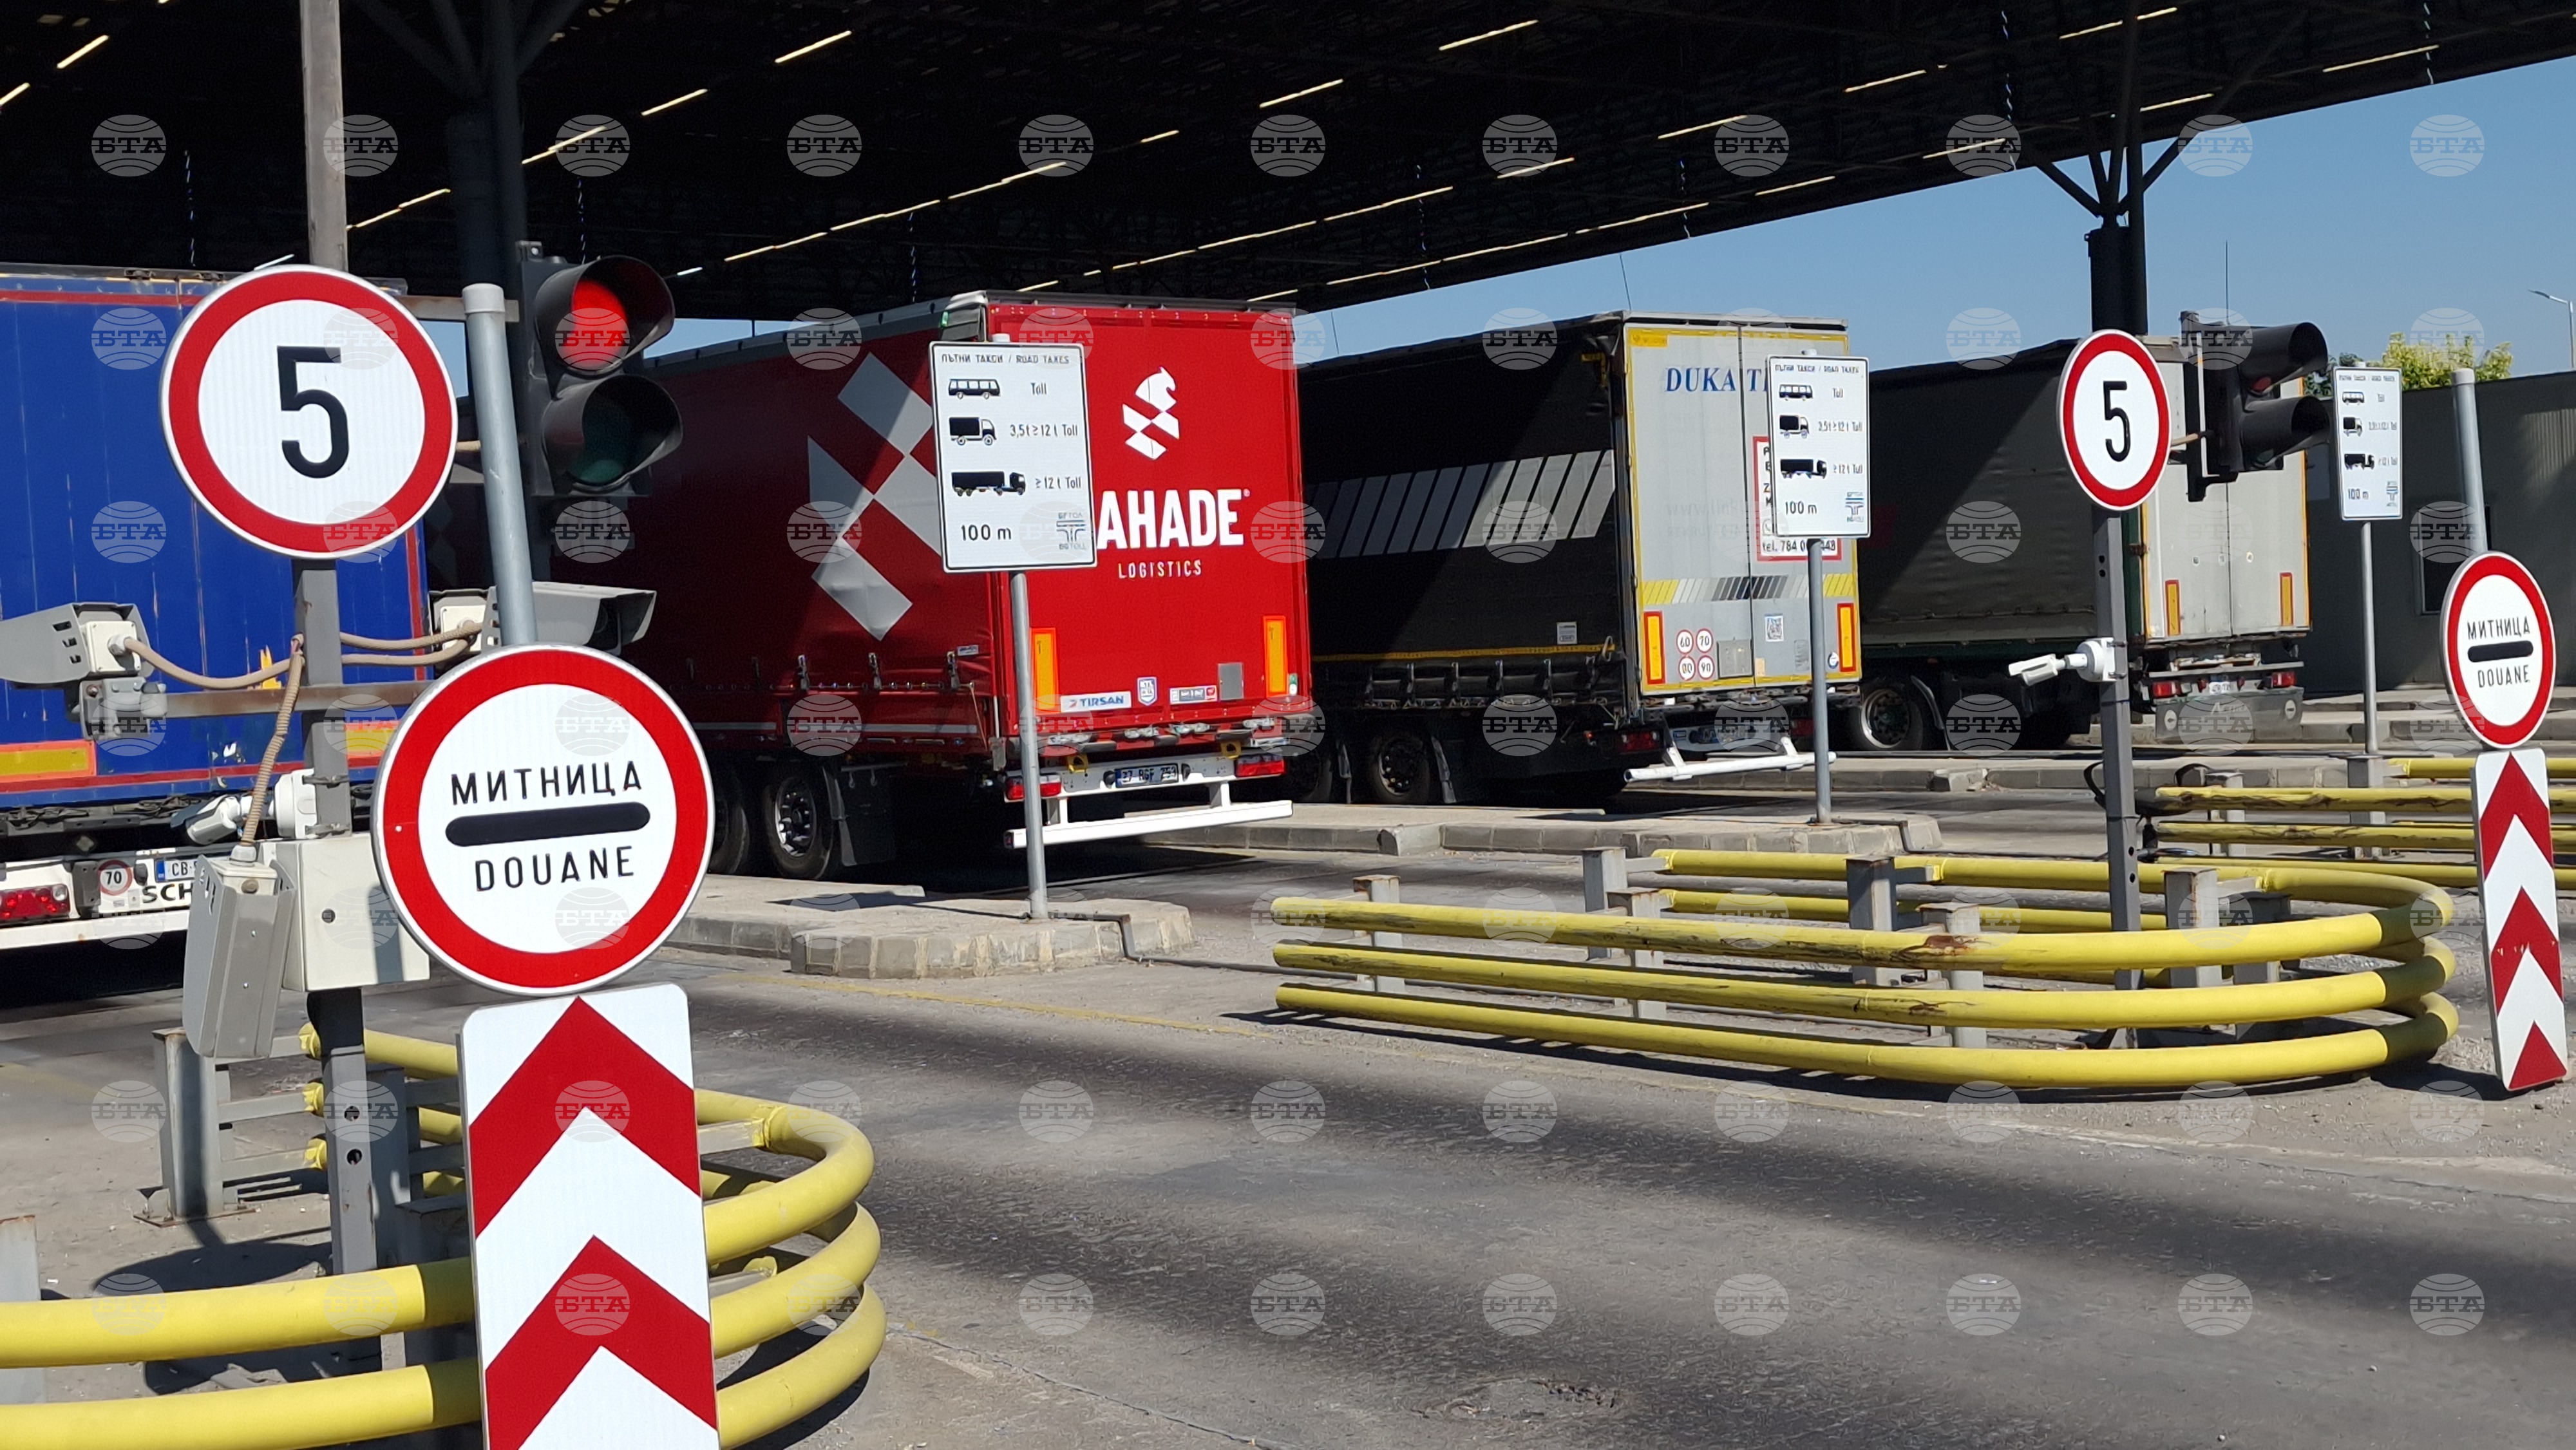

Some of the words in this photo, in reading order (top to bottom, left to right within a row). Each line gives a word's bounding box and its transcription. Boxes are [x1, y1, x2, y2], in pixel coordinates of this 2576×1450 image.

[1030, 382, 1047, 395] Toll
[1665, 368, 1736, 392] DUKA
[276, 345, 349, 478] 5
[1062, 424, 1078, 437] Toll
[2103, 381, 2131, 462] 5
[1065, 476, 1081, 489] Toll
[1785, 501, 1804, 515] 100
[1808, 504, 1817, 514] m
[961, 524, 990, 541] 100
[998, 527, 1012, 540] m
[1118, 560, 1202, 579] LOGISTICS
[2467, 616, 2530, 640] МИТНИЦА
[1700, 635, 1710, 647] 70
[2477, 664, 2530, 688] DOUANE
[1079, 695, 1124, 707] TIRSAN
[451, 760, 642, 805] МИТНИЦА
[475, 845, 634, 892] DOUANE
[106, 871, 122, 885] 70
